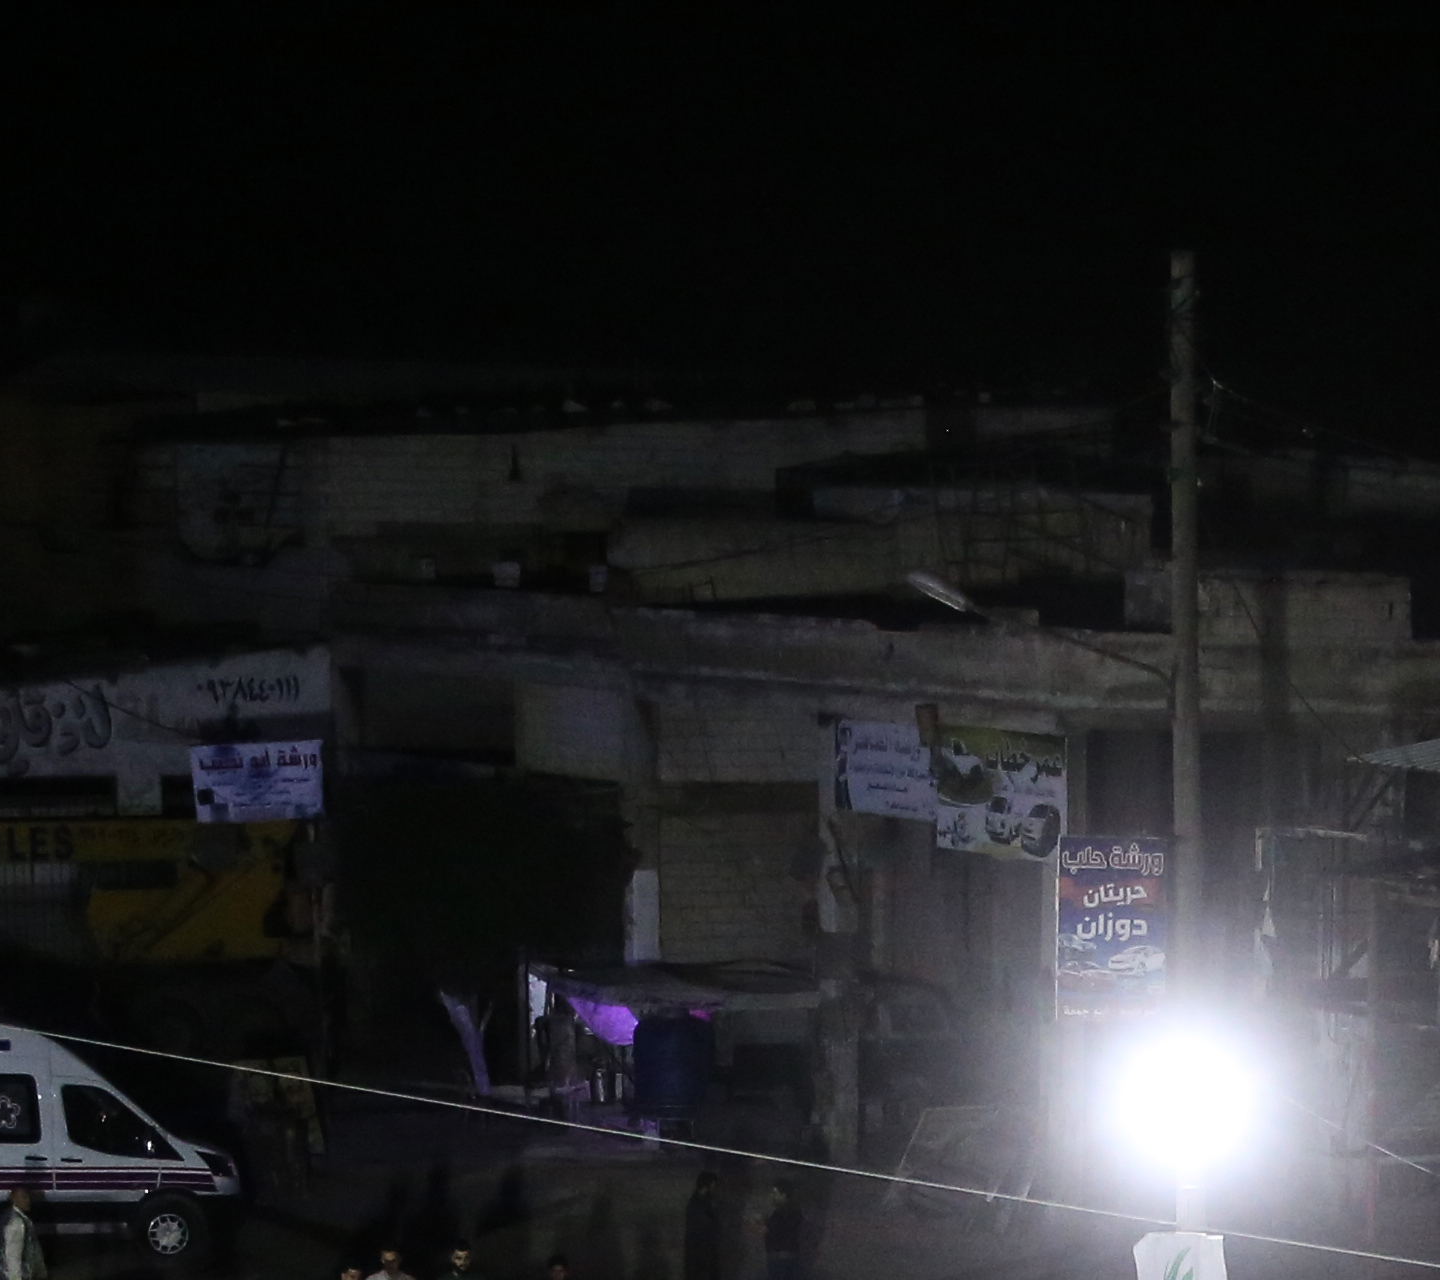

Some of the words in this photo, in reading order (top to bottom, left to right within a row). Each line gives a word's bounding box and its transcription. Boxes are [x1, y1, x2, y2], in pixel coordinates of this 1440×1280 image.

[1061, 845, 1108, 876] حلب
[1108, 843, 1165, 876] ورشة
[1082, 883, 1148, 909] حريتان
[1076, 912, 1150, 942] دوزان
